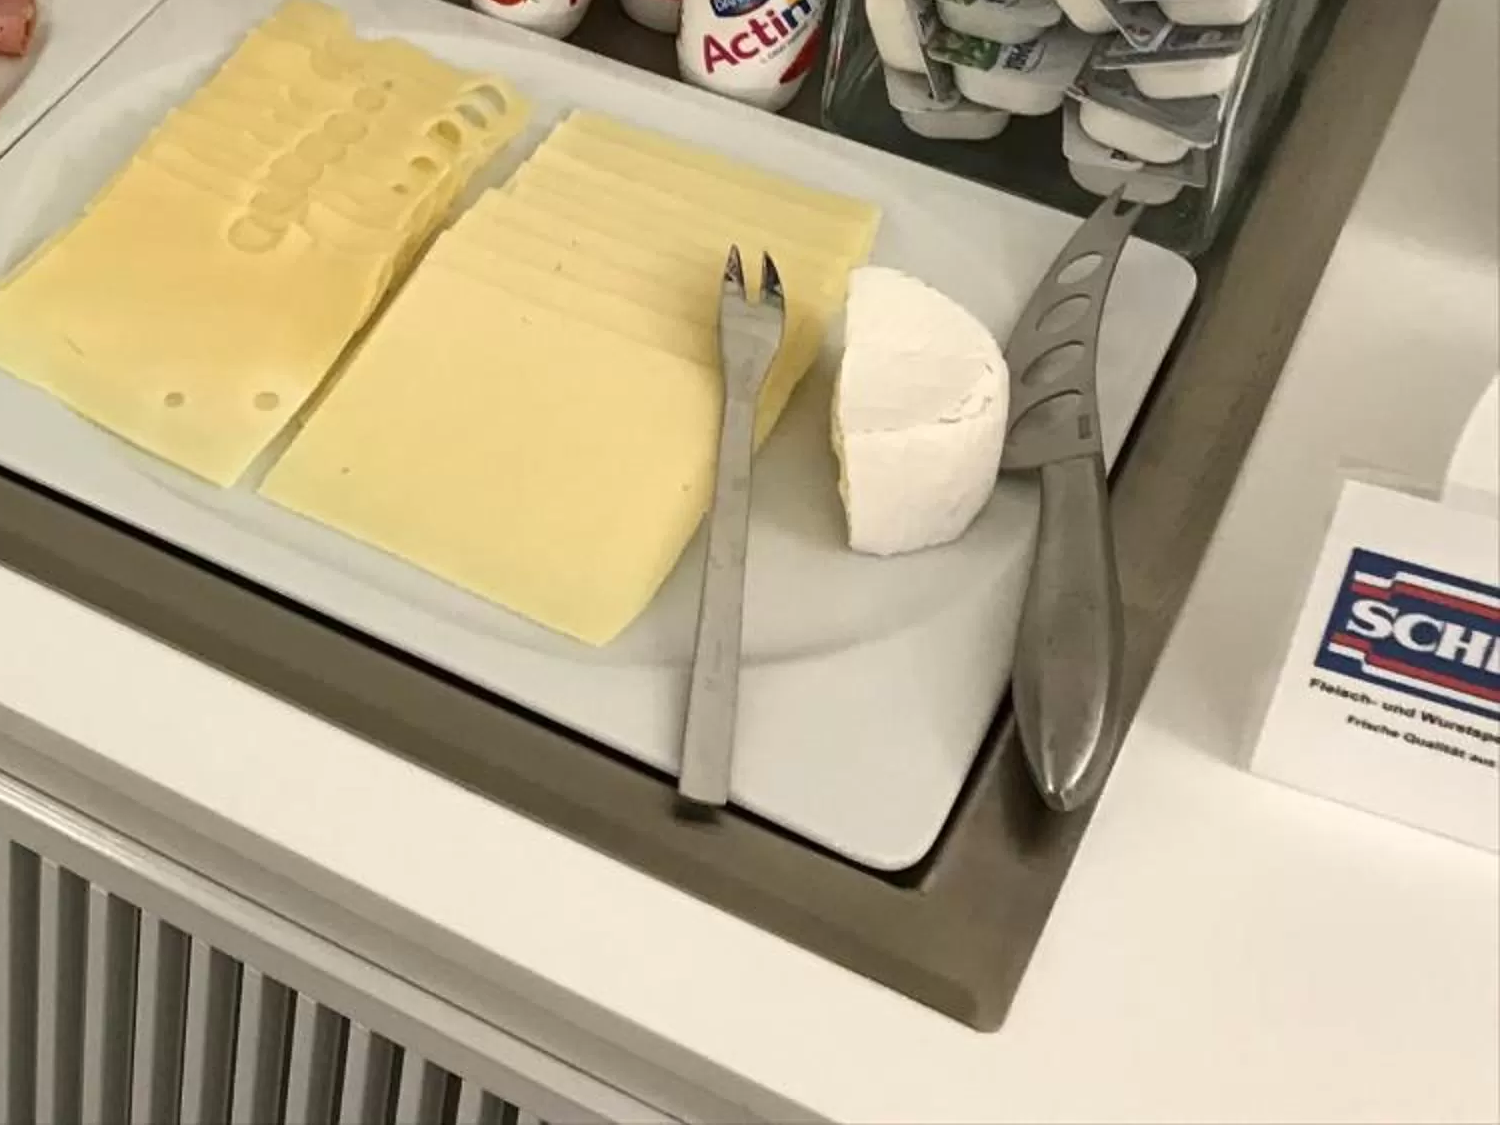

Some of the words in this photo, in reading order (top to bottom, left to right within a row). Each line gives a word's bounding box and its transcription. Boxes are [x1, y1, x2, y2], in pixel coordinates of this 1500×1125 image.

[1309, 677, 1377, 705] Fleisch-
[1381, 702, 1416, 719] und
[1346, 714, 1400, 739] Frische
[1402, 731, 1466, 759] Qualität
[1468, 753, 1497, 769] aus
